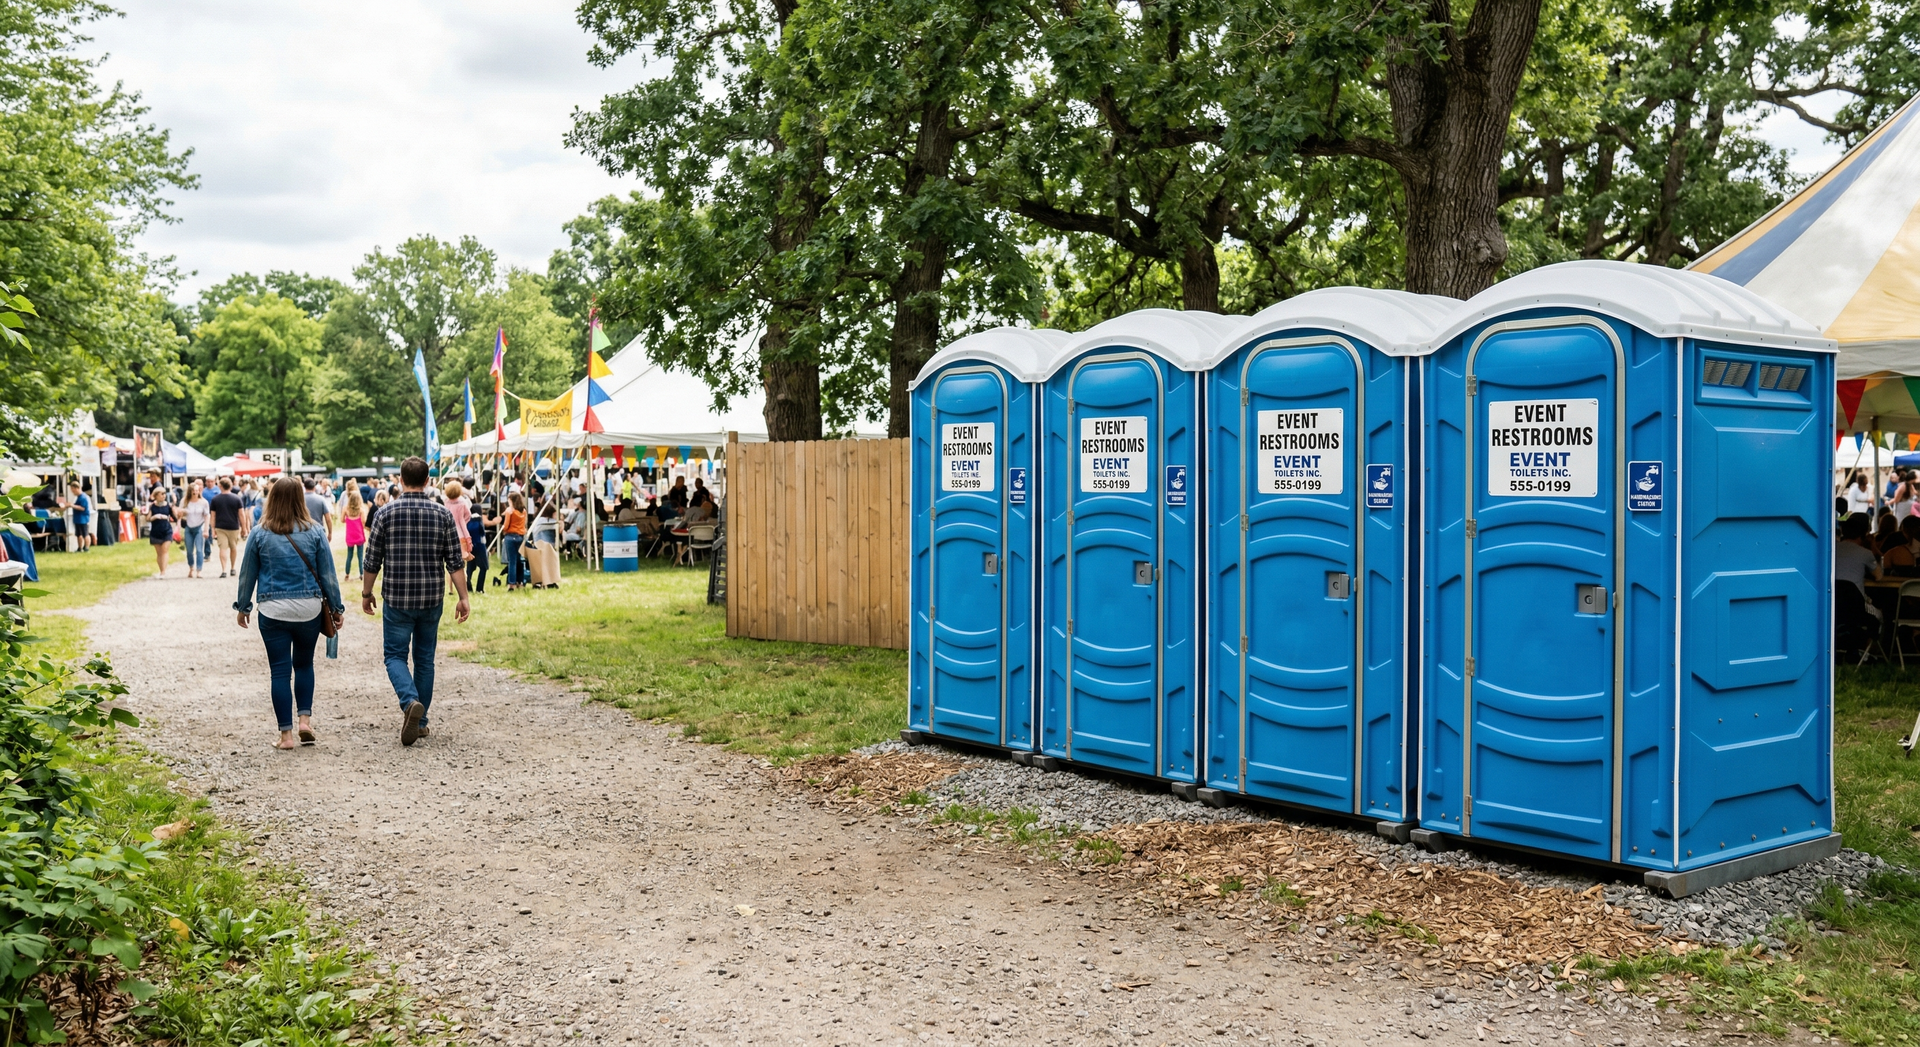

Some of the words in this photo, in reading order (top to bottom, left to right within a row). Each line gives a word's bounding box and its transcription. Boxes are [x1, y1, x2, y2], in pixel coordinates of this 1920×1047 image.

[1515, 404, 1567, 423] EVENT
[1095, 420, 1127, 435] EVENT
[1278, 413, 1318, 429] EVENT
[953, 426, 979, 439] EVENT
[1492, 427, 1593, 446] RESTROOMS
[1082, 438, 1144, 453] RESTROOMS
[1260, 433, 1339, 450] RESTROOMS
[943, 442, 992, 456] RESTROOMS
[952, 460, 980, 471] EVENT
[1093, 458, 1130, 469] EVENT
[1274, 455, 1321, 468] EVENT
[1510, 452, 1571, 467] EVENT
[1274, 470, 1304, 478] TOILETS
[1306, 470, 1322, 478] INC.
[1510, 469, 1548, 478] TOILETS
[1552, 469, 1571, 478] INC.
[952, 480, 980, 488] 555-0199
[1093, 480, 1130, 489] 555-0199
[1275, 480, 1321, 490] 555-0199
[1510, 480, 1571, 492] 555-0199
